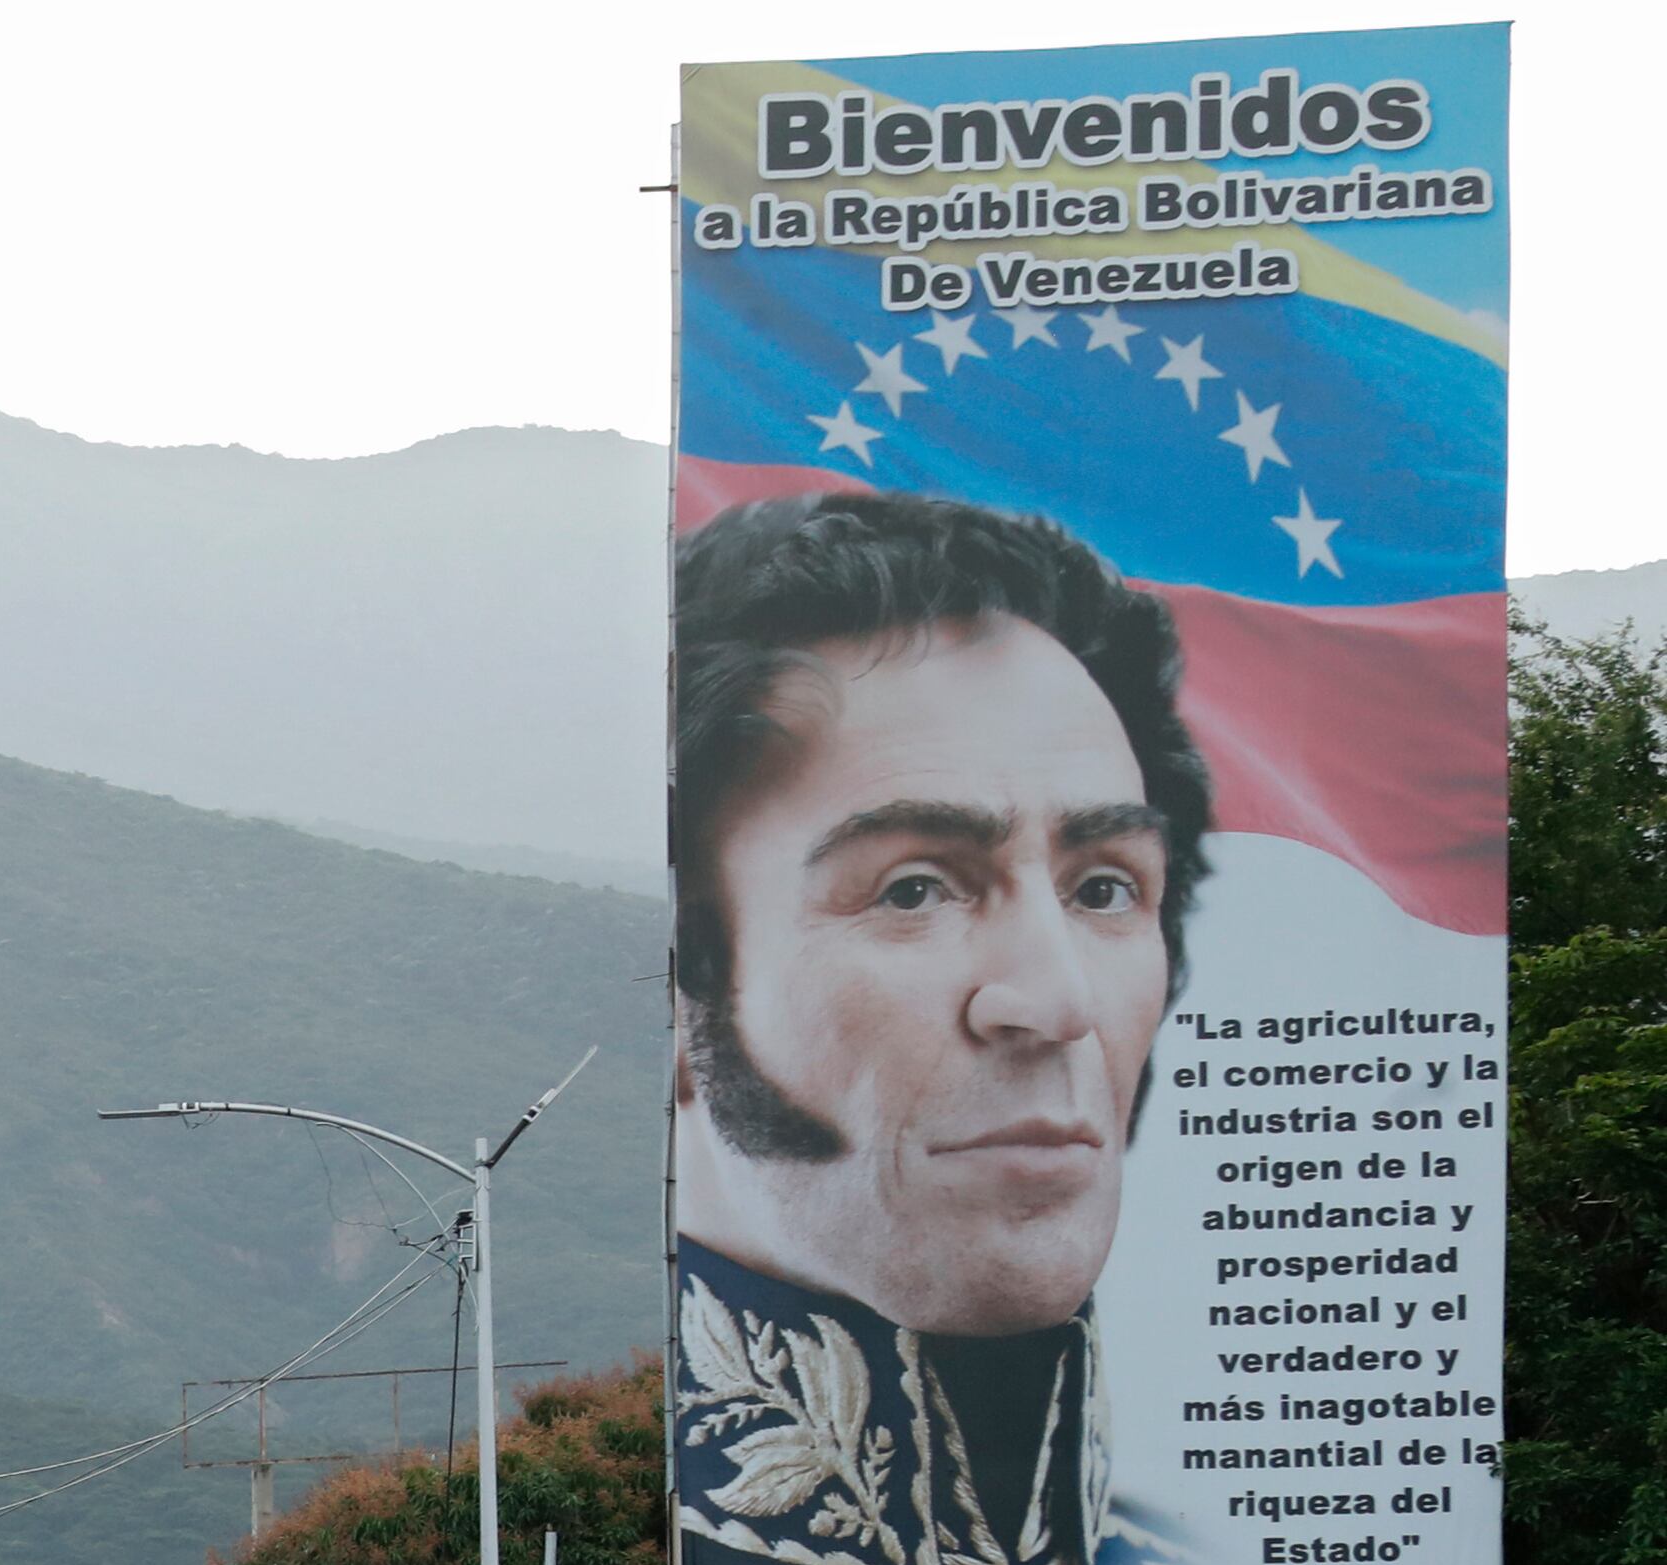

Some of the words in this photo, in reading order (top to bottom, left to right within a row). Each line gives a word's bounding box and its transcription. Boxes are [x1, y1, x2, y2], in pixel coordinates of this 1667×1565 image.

[765, 75, 1424, 172] Bienvenidos
[703, 208, 735, 241] a
[758, 200, 806, 239] la
[831, 190, 1122, 244] República
[1144, 167, 1485, 223] Bolivariana
[890, 262, 963, 304] De
[988, 248, 1291, 299] Venezuela
[1175, 1012, 1242, 1039] "La
[1257, 1008, 1495, 1044] agricultura,
[1173, 1061, 1208, 1088] el
[1223, 1056, 1412, 1086] comercio
[1426, 1060, 1449, 1088] y
[1463, 1054, 1499, 1081] la
[1179, 1106, 1357, 1135] industria
[1371, 1107, 1442, 1132] son
[1457, 1102, 1494, 1128] el
[1216, 1155, 1342, 1188] origen
[1357, 1152, 1406, 1180] de
[1421, 1150, 1457, 1178] la
[1202, 1200, 1436, 1231] abundancia
[1450, 1204, 1473, 1232] y
[1217, 1246, 1458, 1285] prosperidad
[1209, 1296, 1379, 1326] nacional
[1395, 1301, 1417, 1328] y
[1432, 1294, 1467, 1321] el
[1218, 1345, 1422, 1373] verdadero
[1436, 1348, 1460, 1375] y
[1183, 1395, 1265, 1422] más
[1280, 1390, 1496, 1425] inagotable
[1183, 1439, 1383, 1469] manantial
[1398, 1438, 1446, 1466] de
[1462, 1438, 1499, 1464] la
[1228, 1490, 1375, 1522] riqueza
[1391, 1486, 1451, 1514] del
[1262, 1535, 1421, 1564] Estado"
